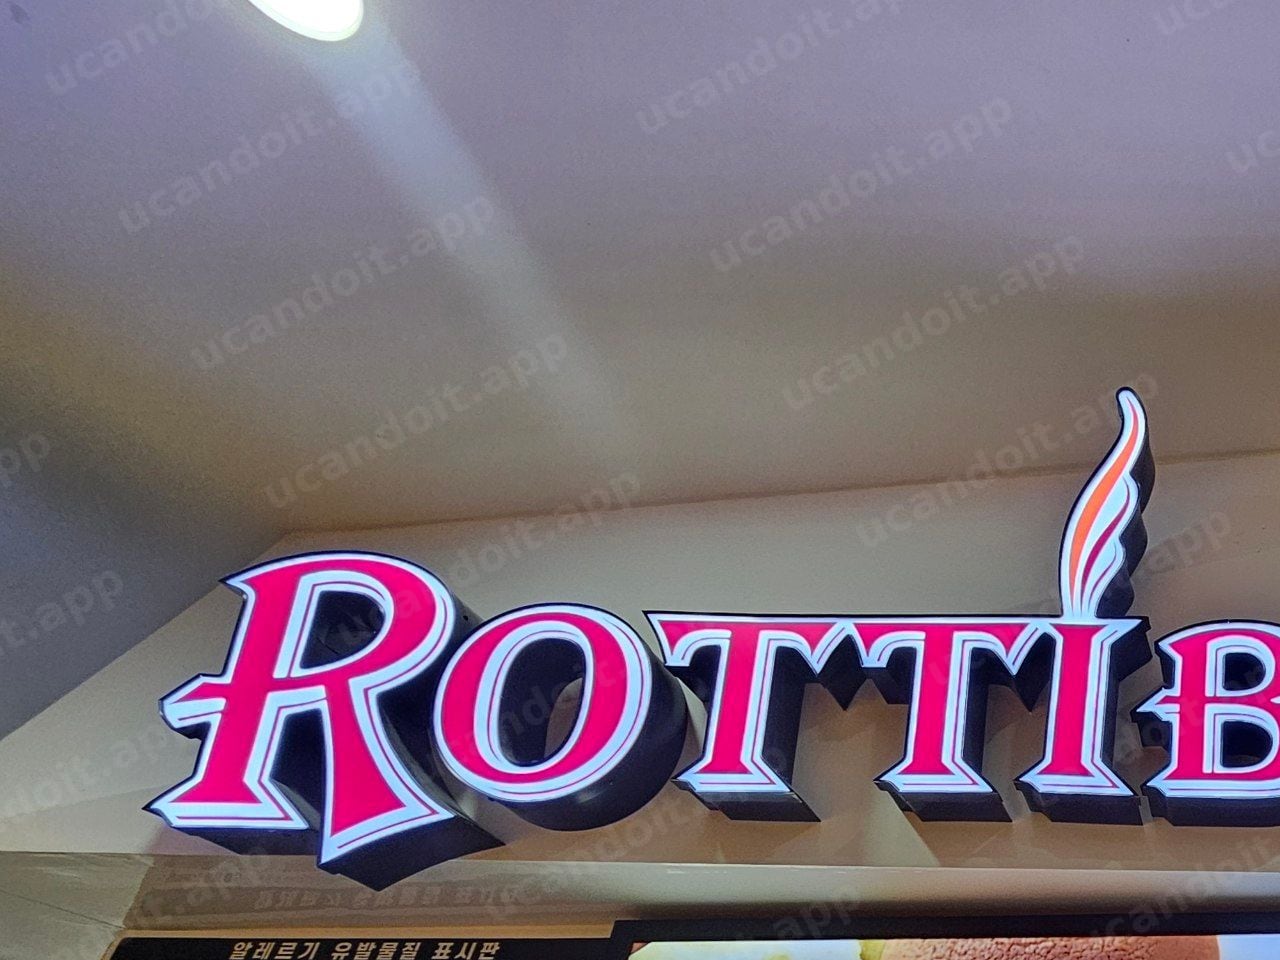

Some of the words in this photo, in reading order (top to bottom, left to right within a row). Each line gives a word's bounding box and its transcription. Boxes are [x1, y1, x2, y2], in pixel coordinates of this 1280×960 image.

[229, 941, 321, 960] 알레르기
[331, 941, 422, 960] 유발물질
[431, 941, 501, 960] 표시판
